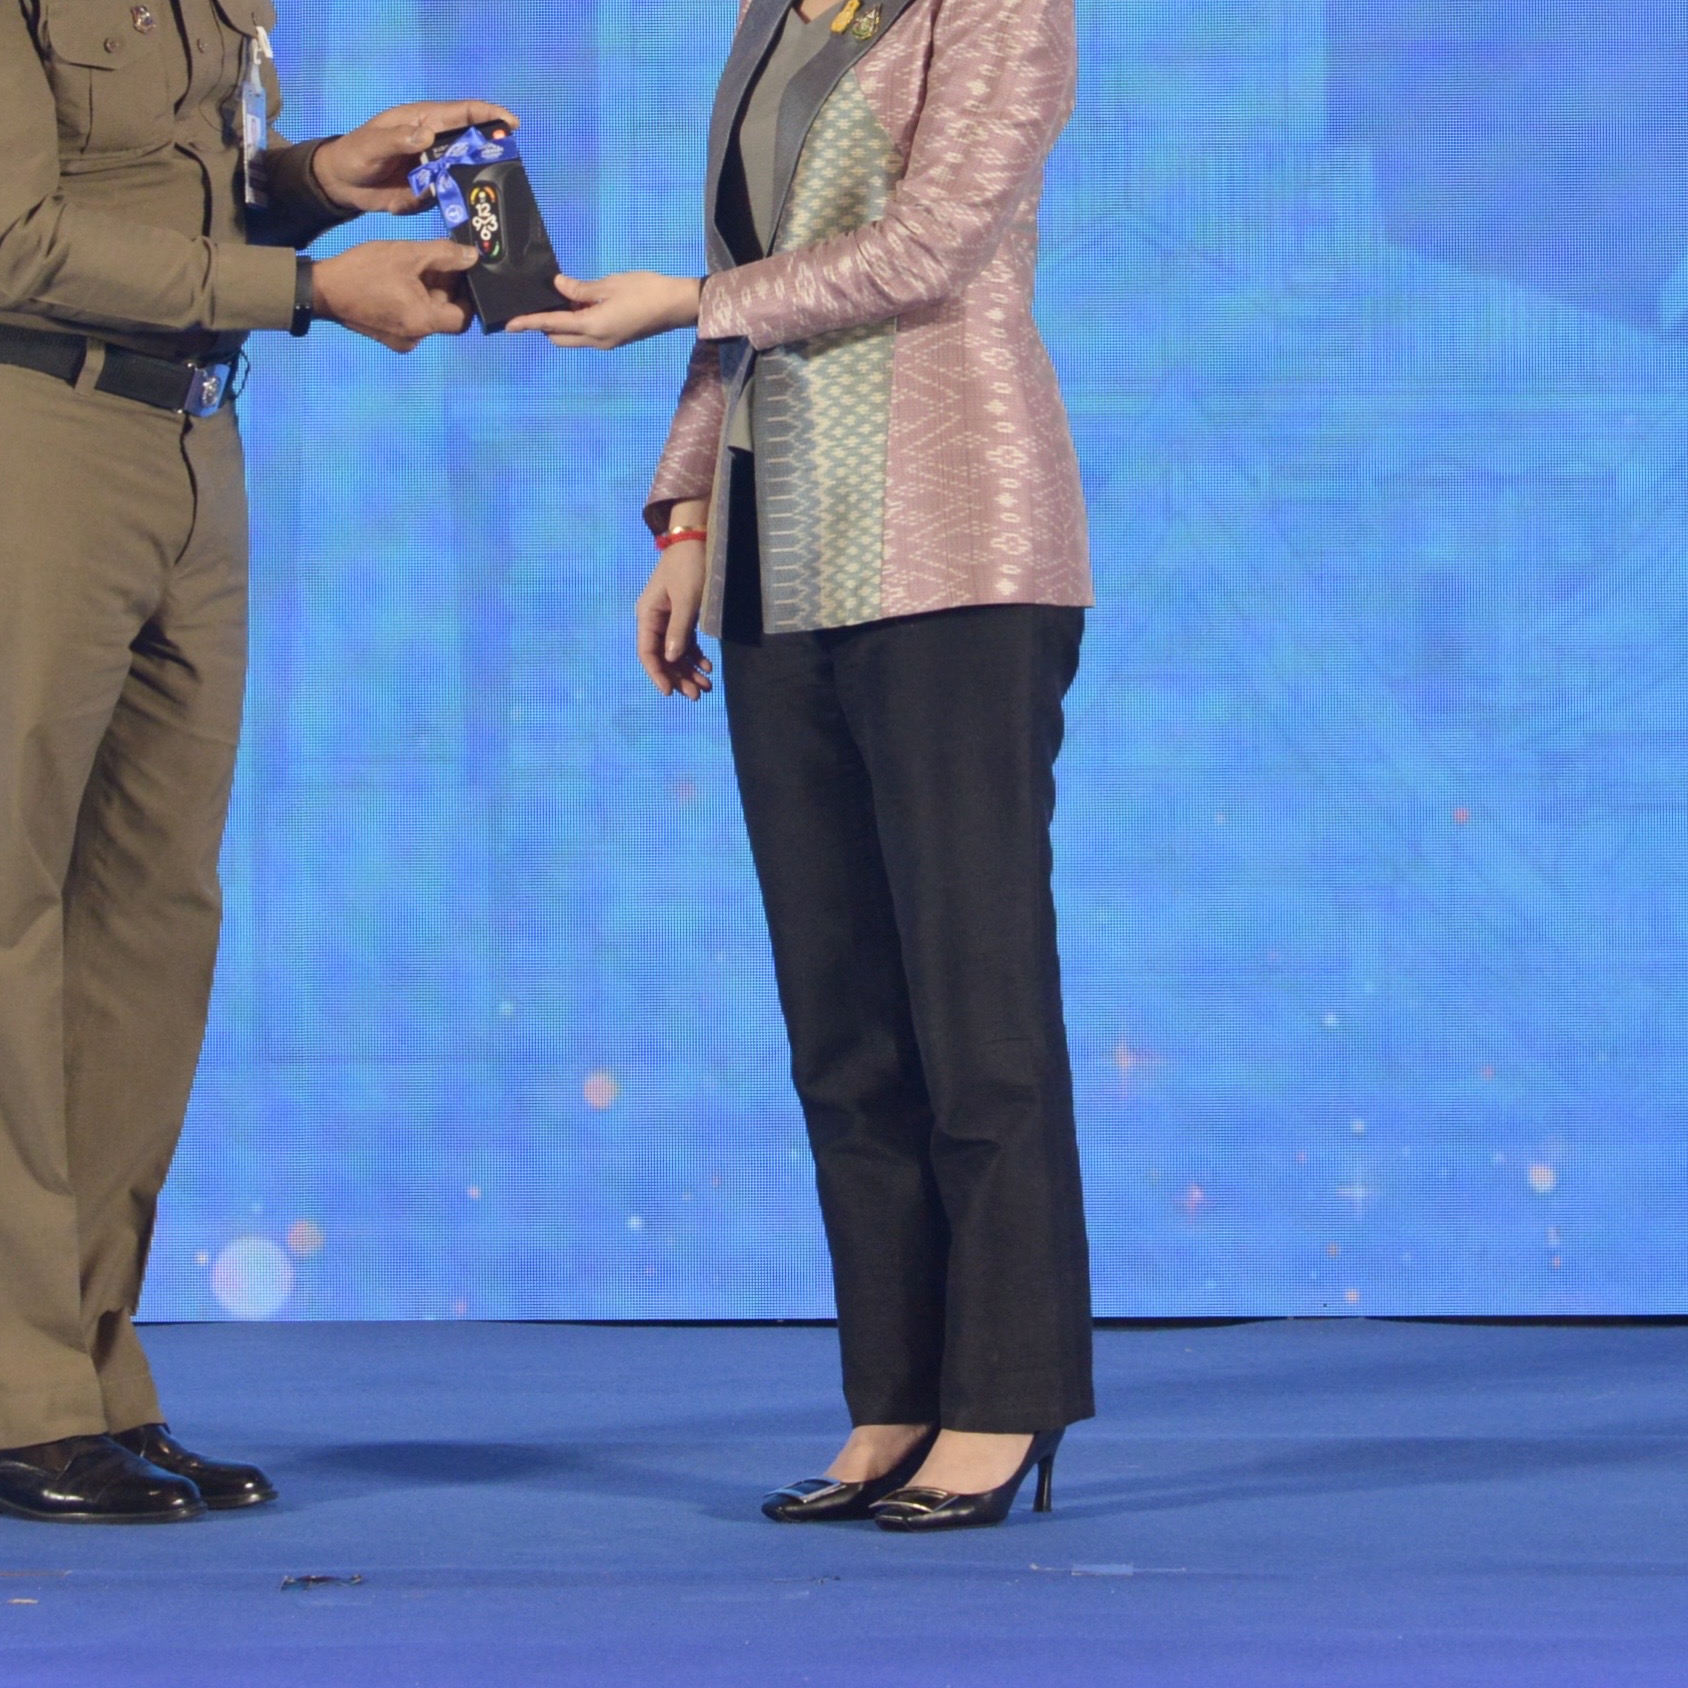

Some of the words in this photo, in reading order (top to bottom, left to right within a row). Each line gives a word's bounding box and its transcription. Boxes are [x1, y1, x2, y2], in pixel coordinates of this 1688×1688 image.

[475, 202, 492, 218] 12
[472, 216, 483, 232] 9
[480, 225, 492, 241] 6
